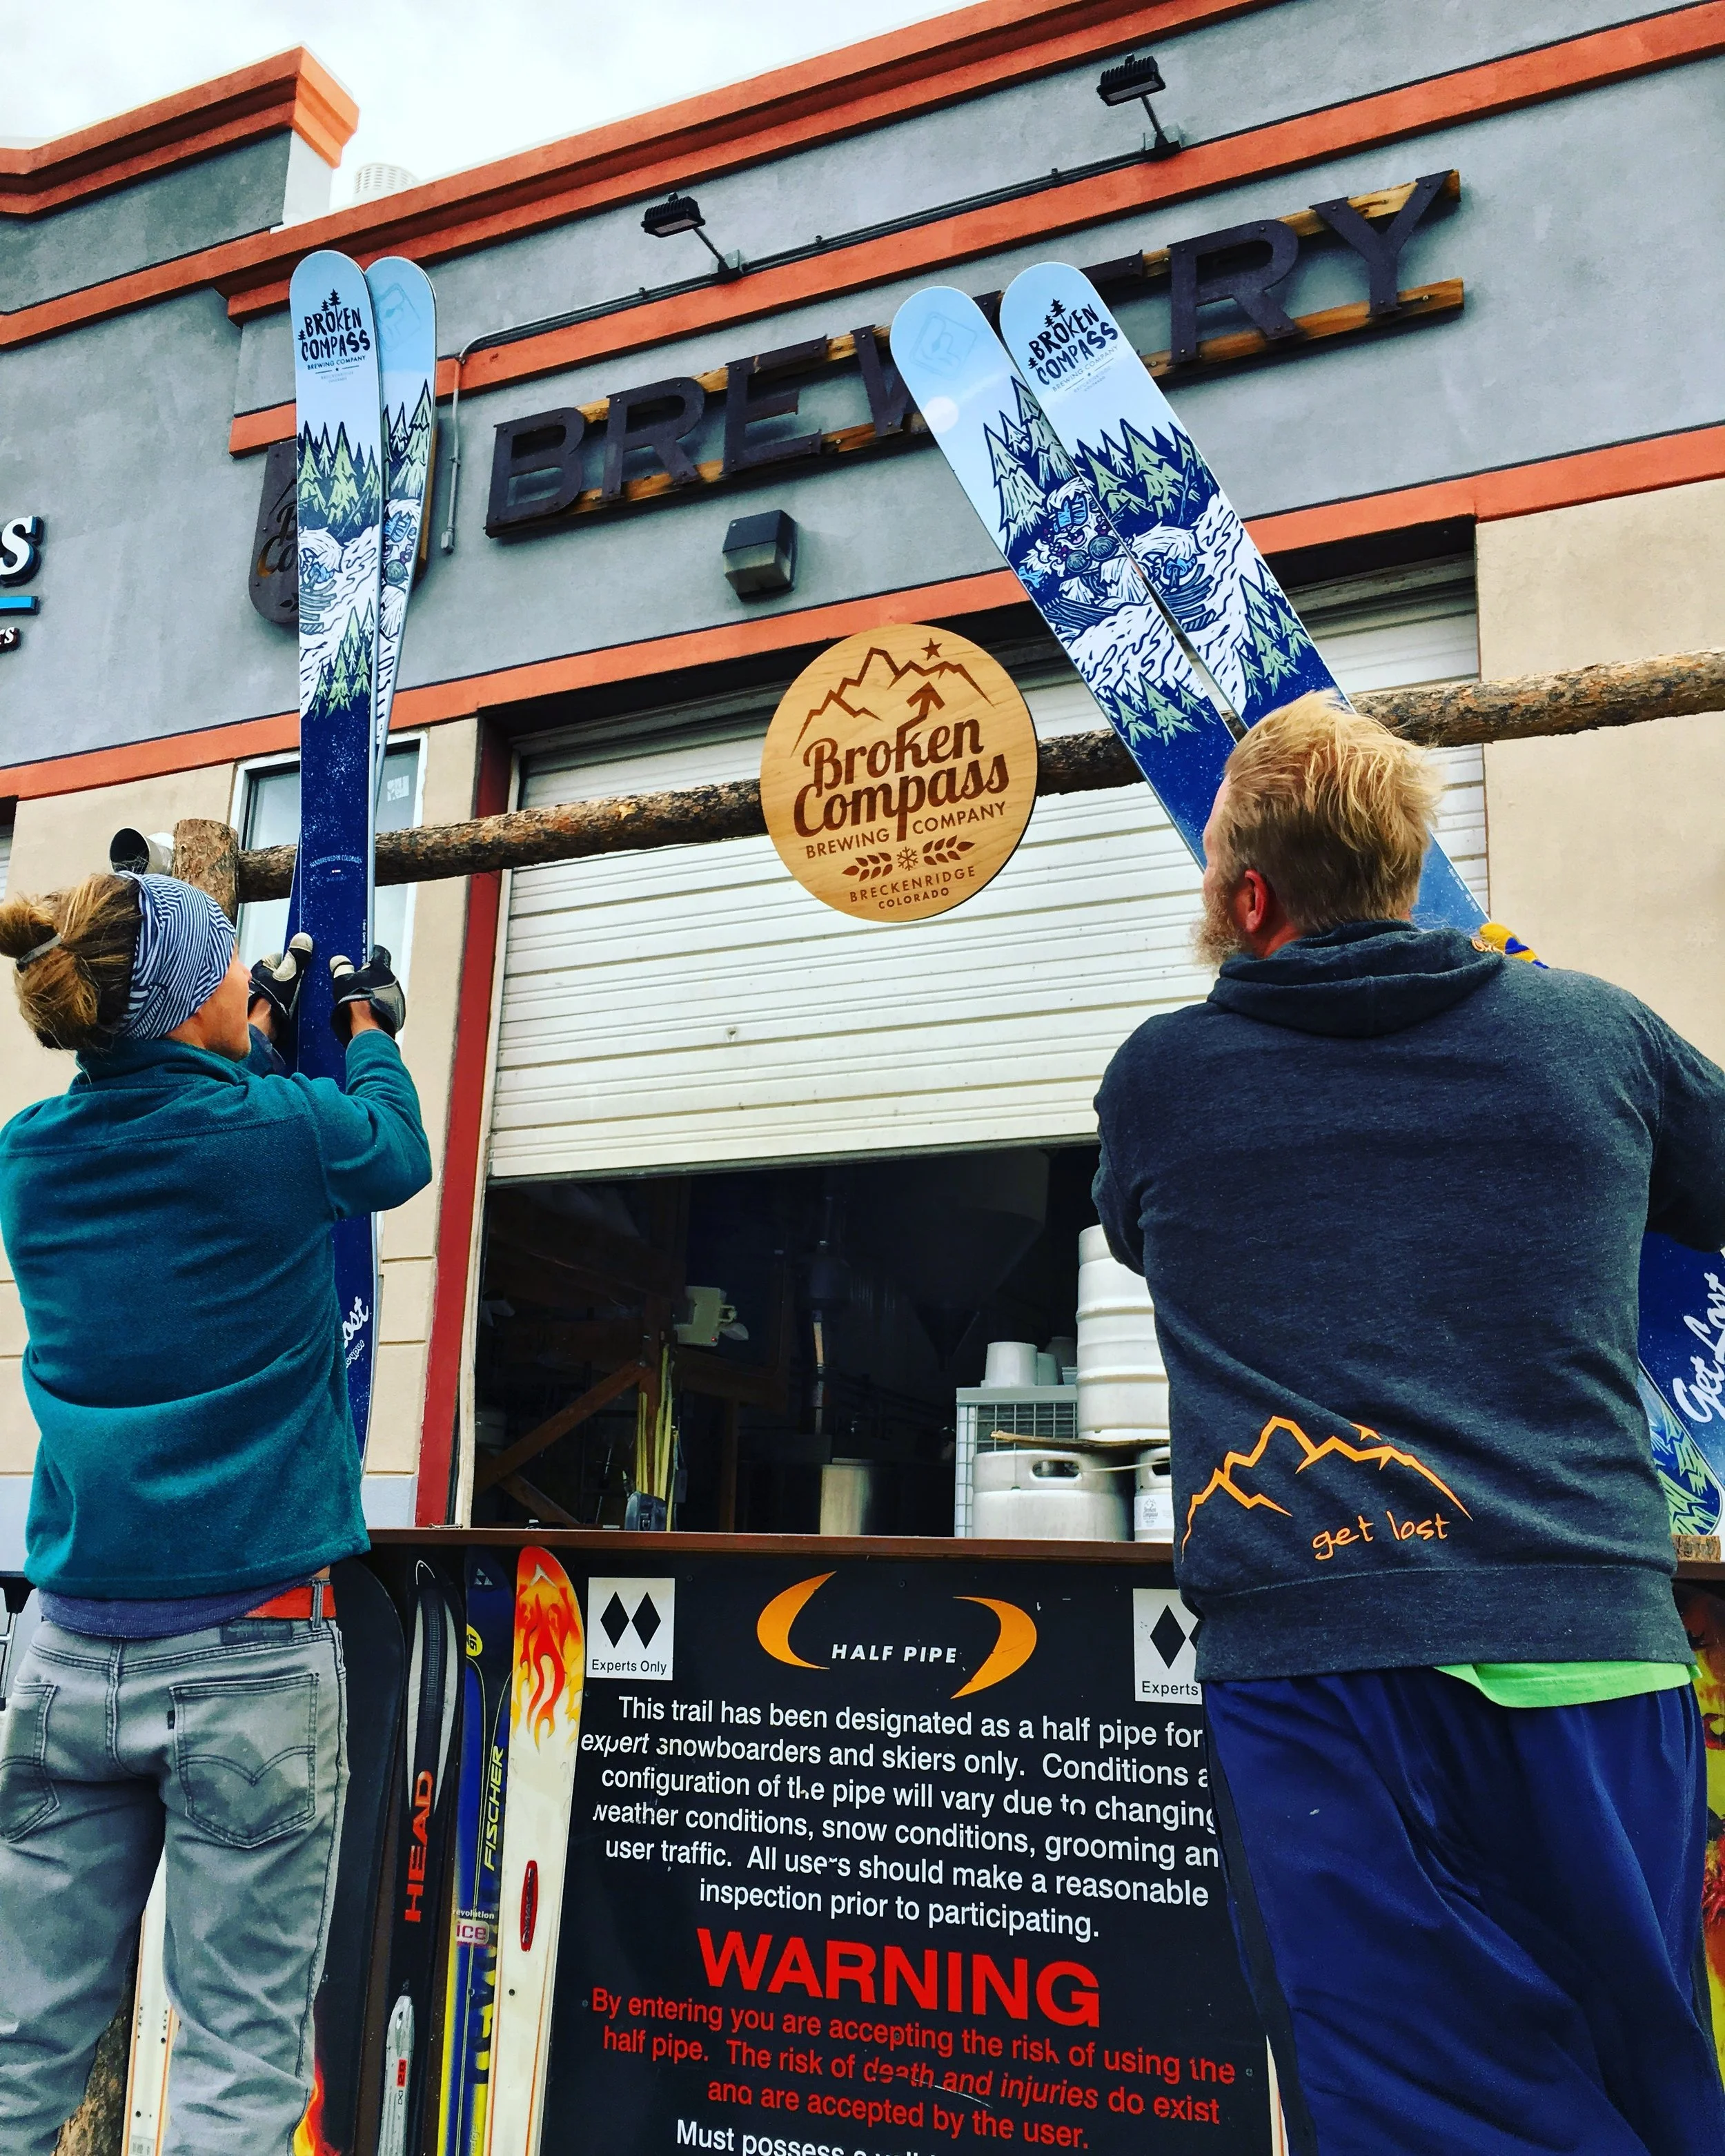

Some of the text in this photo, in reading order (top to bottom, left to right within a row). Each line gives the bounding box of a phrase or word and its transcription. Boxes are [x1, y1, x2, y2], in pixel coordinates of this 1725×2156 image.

[301, 329, 371, 362] COMPASS
[304, 307, 362, 337] BROKEN
[1028, 304, 1100, 363] BROKEN
[307, 355, 366, 370] BREWING COMPANY
[487, 170, 1456, 537] BRERY
[1037, 321, 1118, 386] COMPASS
[1052, 344, 1118, 392] BREWING COMPANY
[804, 715, 985, 798] Broken
[793, 753, 1010, 842] Compass
[805, 801, 1006, 859] BREWING COMPANY
[849, 865, 976, 903] BRECKENRIDGE
[878, 888, 950, 910] COLORADO
[342, 1296, 369, 1349] ost
[1312, 1511, 1450, 1560] get lost
[591, 1659, 667, 1675] Experts Only
[832, 1645, 956, 1663] HALF PIPE
[1141, 1680, 1199, 1697] Experts
[619, 1696, 1203, 1750] This trail has been designated as a half pipe for
[582, 1734, 649, 1757] expert
[656, 1736, 820, 1763] snowboarders
[829, 1744, 873, 1766] and
[883, 1745, 955, 1771] skiers
[965, 1751, 1024, 1781] only.
[1043, 1753, 1188, 1785] Conditions
[484, 1745, 504, 1872] FISCHER
[602, 1767, 749, 1796] configuration
[758, 1774, 780, 1797] of
[787, 1776, 824, 1800] the
[834, 1779, 885, 1809] pipe
[893, 1783, 931, 1807] will
[941, 1791, 994, 1817] vary
[1004, 1790, 1052, 1815] due
[1061, 1794, 1085, 1815] to
[404, 1770, 433, 1923] HEAD
[593, 1802, 1218, 1870] weather conditions, snow conditions, grooming an
[607, 1841, 1208, 1906] user traffic. All users should make a reasonable
[452, 1908, 495, 1919] revolution
[455, 1921, 486, 1940] ice
[700, 1878, 1098, 1943] inspection prior to participating.
[697, 1928, 1099, 2028] WARNING
[593, 1988, 1234, 2084] By entering you are accepting the risk of using the
[604, 2026, 1219, 2124] half pipe. The risk of death and injuries do exist
[678, 2119, 844, 2156] Must possess
[761, 2088, 799, 2110] are
[808, 2095, 923, 2127] accepted
[934, 2104, 964, 2138] by
[972, 2110, 1014, 2139] the
[1024, 2122, 1087, 2148] user.
